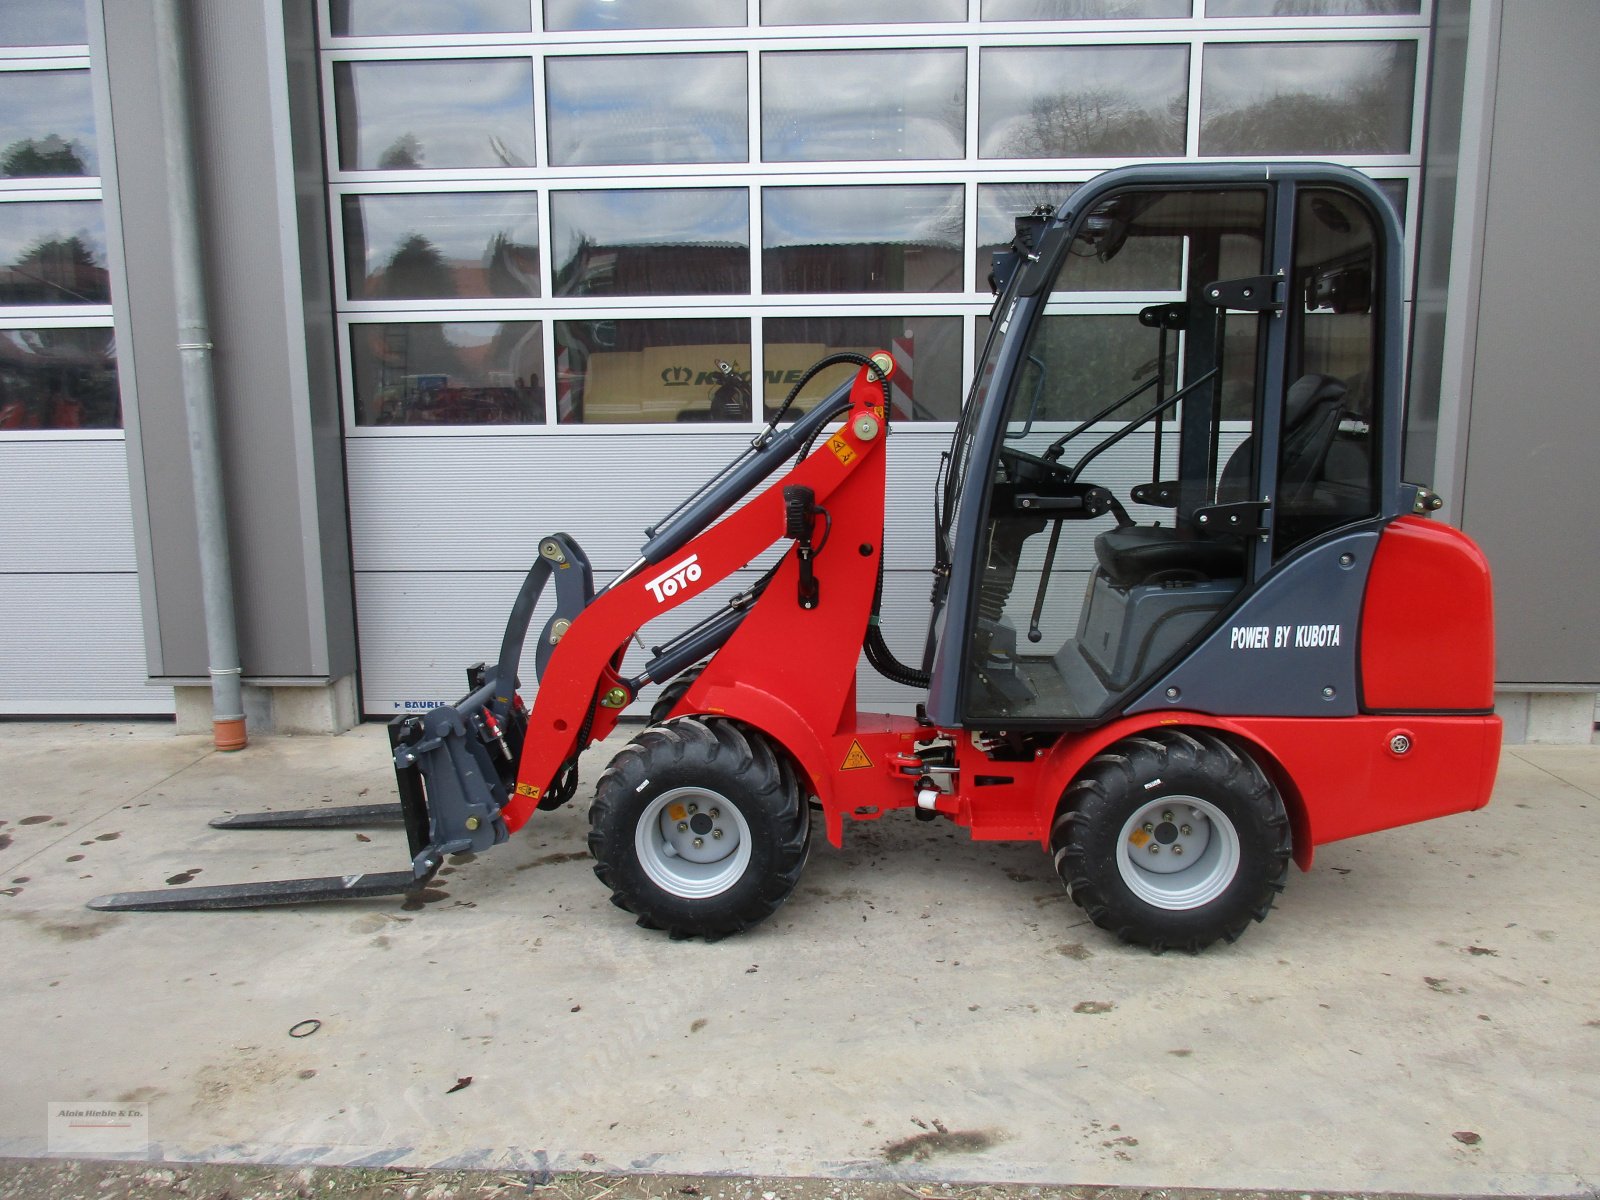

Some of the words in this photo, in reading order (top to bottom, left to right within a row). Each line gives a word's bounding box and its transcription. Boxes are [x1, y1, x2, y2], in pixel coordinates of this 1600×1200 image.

[695, 370, 803, 386] KNE
[644, 554, 702, 603] TOYO
[1230, 626, 1270, 649] POWER
[1274, 625, 1291, 648] BY
[1295, 624, 1340, 647] KUBOTA
